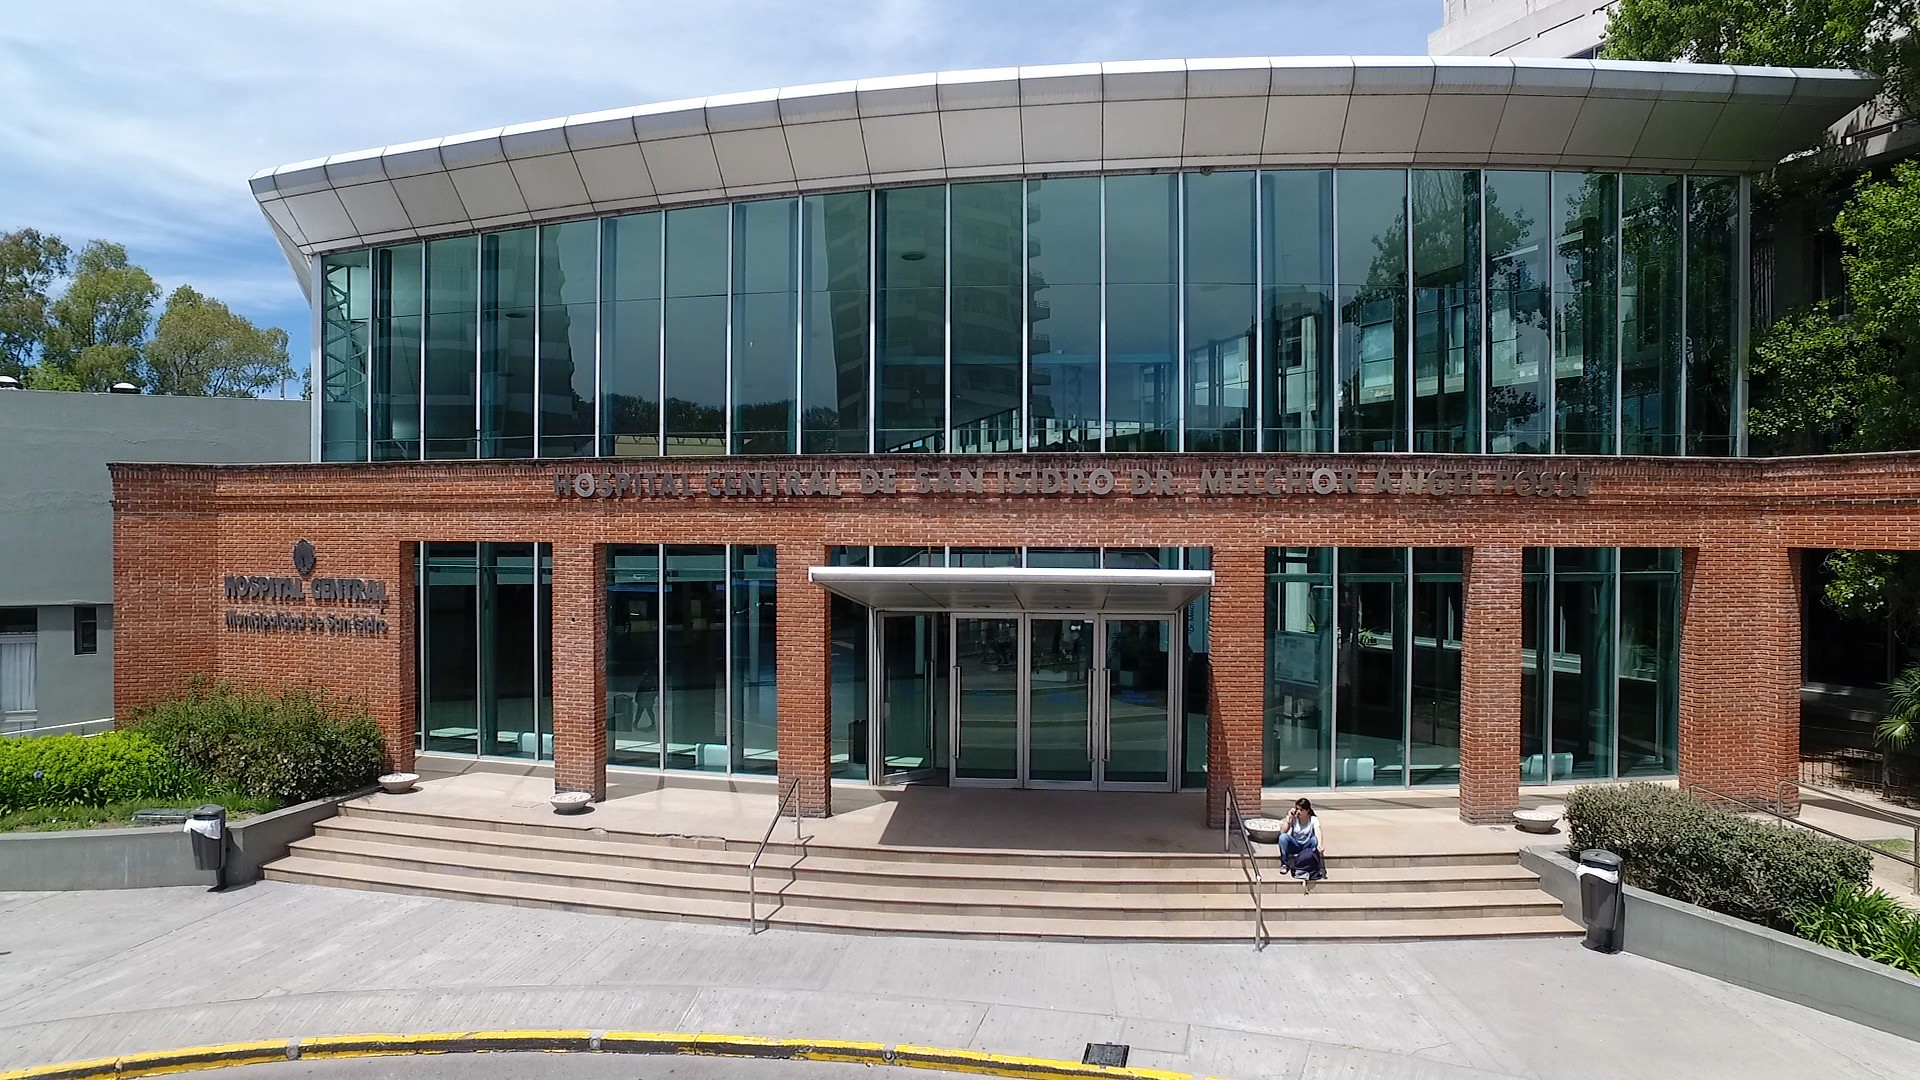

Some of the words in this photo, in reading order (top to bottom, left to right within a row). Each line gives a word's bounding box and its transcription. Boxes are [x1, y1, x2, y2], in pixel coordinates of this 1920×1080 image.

[553, 472, 694, 498] HOSPITAL
[705, 470, 842, 496] CENTRAL
[860, 468, 897, 494] DE
[915, 467, 984, 494] SAN
[997, 467, 1114, 495] ISIDRO
[1130, 468, 1187, 496] DR.
[1198, 467, 1359, 496] MELCHOR
[1495, 470, 1592, 498] POSSE
[223, 575, 305, 599] HOSPITAL
[311, 578, 388, 602] CENTRAL
[225, 610, 305, 634] Municipalidad
[308, 613, 325, 631] de
[327, 614, 351, 633] San
[353, 614, 389, 635] Isidro
